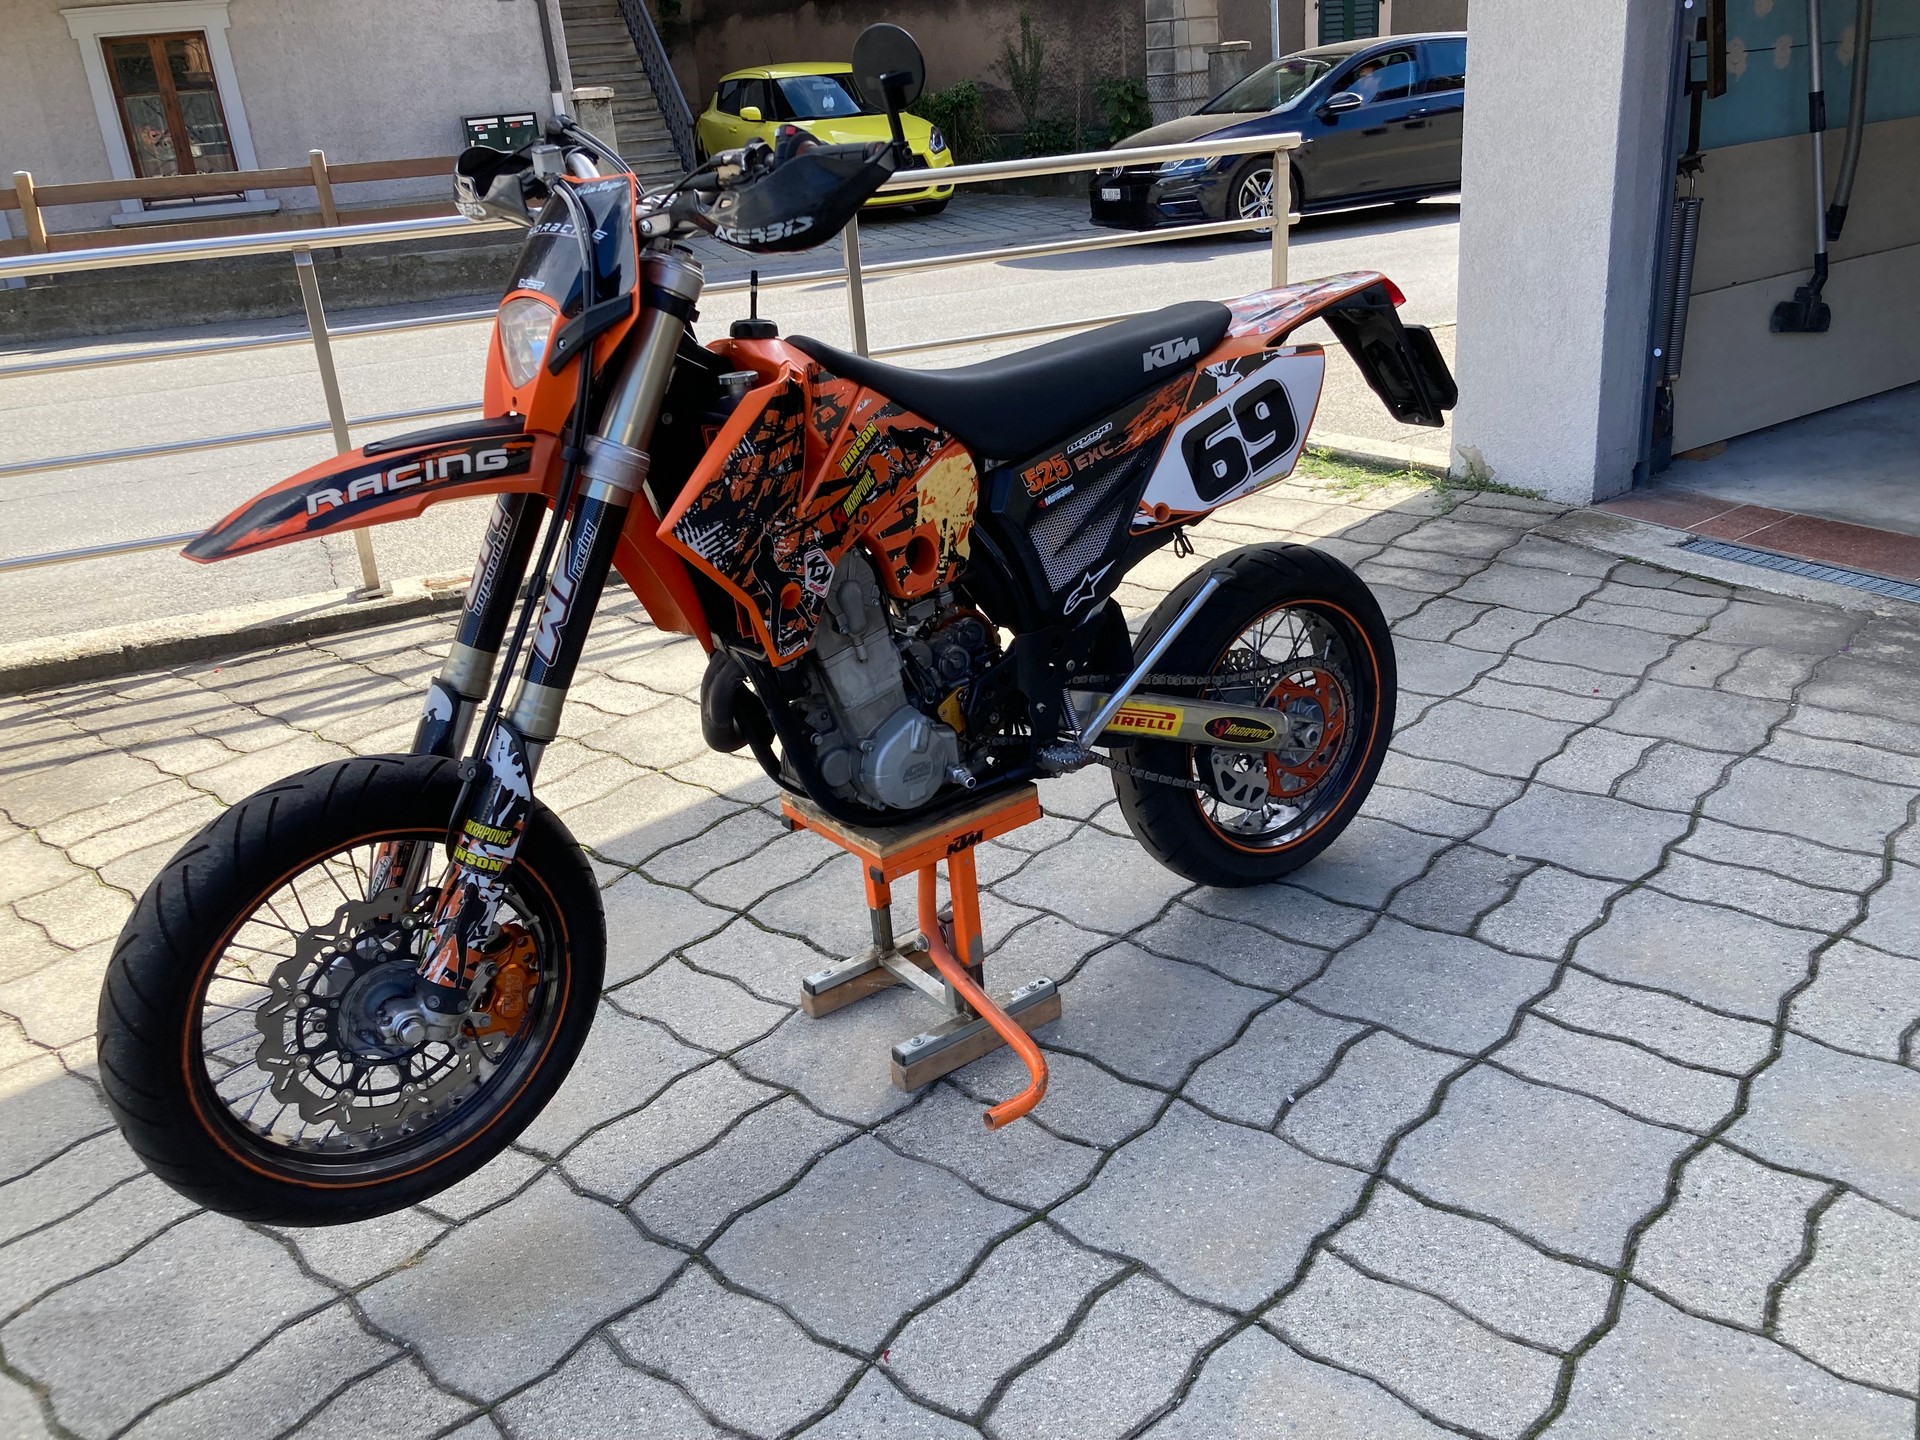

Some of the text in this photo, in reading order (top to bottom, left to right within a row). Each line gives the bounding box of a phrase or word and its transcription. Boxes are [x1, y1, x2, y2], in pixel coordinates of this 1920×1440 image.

[714, 216, 814, 245] ACERBIS
[1143, 337, 1200, 373] KTM
[840, 421, 878, 473] HINSON
[1020, 452, 1073, 498] 525
[1074, 439, 1115, 471] EXC
[1181, 378, 1300, 506] 69
[306, 448, 509, 516] RACING
[474, 513, 513, 616] suspension
[574, 519, 598, 583] racing
[945, 828, 985, 856] KTM
